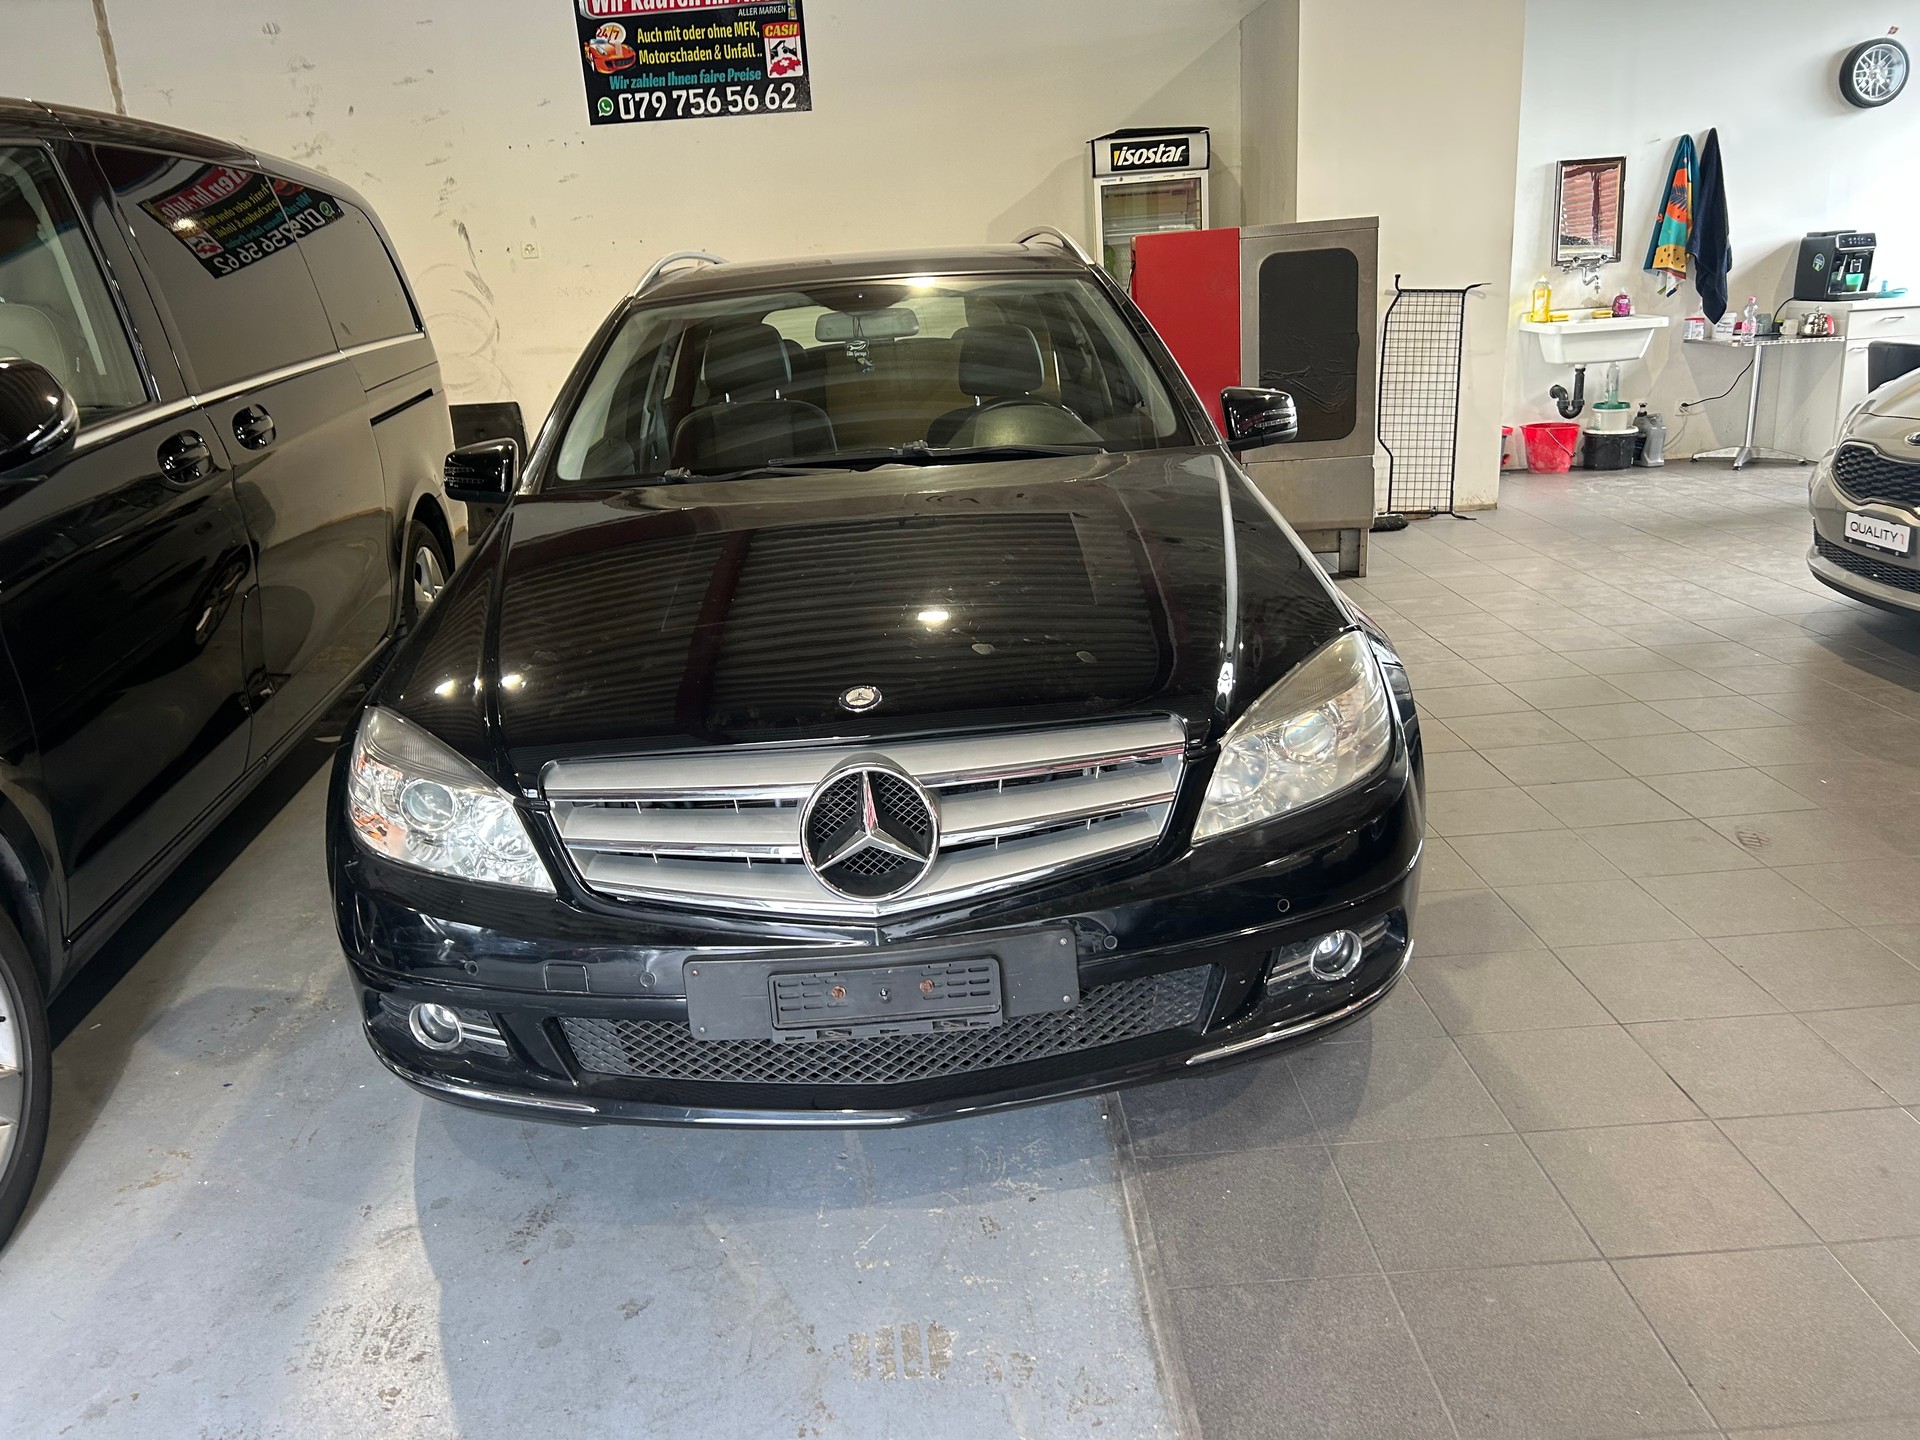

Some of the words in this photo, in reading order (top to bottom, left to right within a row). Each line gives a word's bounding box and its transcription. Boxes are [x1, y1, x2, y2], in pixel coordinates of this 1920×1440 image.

[738, 7, 758, 17] ALLER
[758, 5, 787, 15] MARKEN
[597, 26, 620, 40] 24/7
[637, 26, 662, 44] Auch
[663, 25, 682, 42] mit
[682, 24, 706, 40] oder
[707, 23, 733, 39] ohne
[733, 21, 760, 38] MFK,
[764, 24, 798, 37] CASH
[638, 46, 713, 65] Motorschaden
[714, 44, 722, 60] &
[723, 42, 756, 60] Unfall
[609, 75, 630, 91] Wir
[631, 72, 665, 89] zahlen
[667, 70, 698, 87] Ihnen
[699, 69, 727, 84] faire
[727, 67, 762, 83] Preise
[618, 91, 667, 120] 079
[672, 87, 722, 116] 756
[726, 85, 760, 114] 56
[764, 83, 797, 111] 62
[1117, 143, 1187, 166] isostar
[1851, 522, 1898, 542] QUALITY
[1900, 534, 1905, 545] 1
